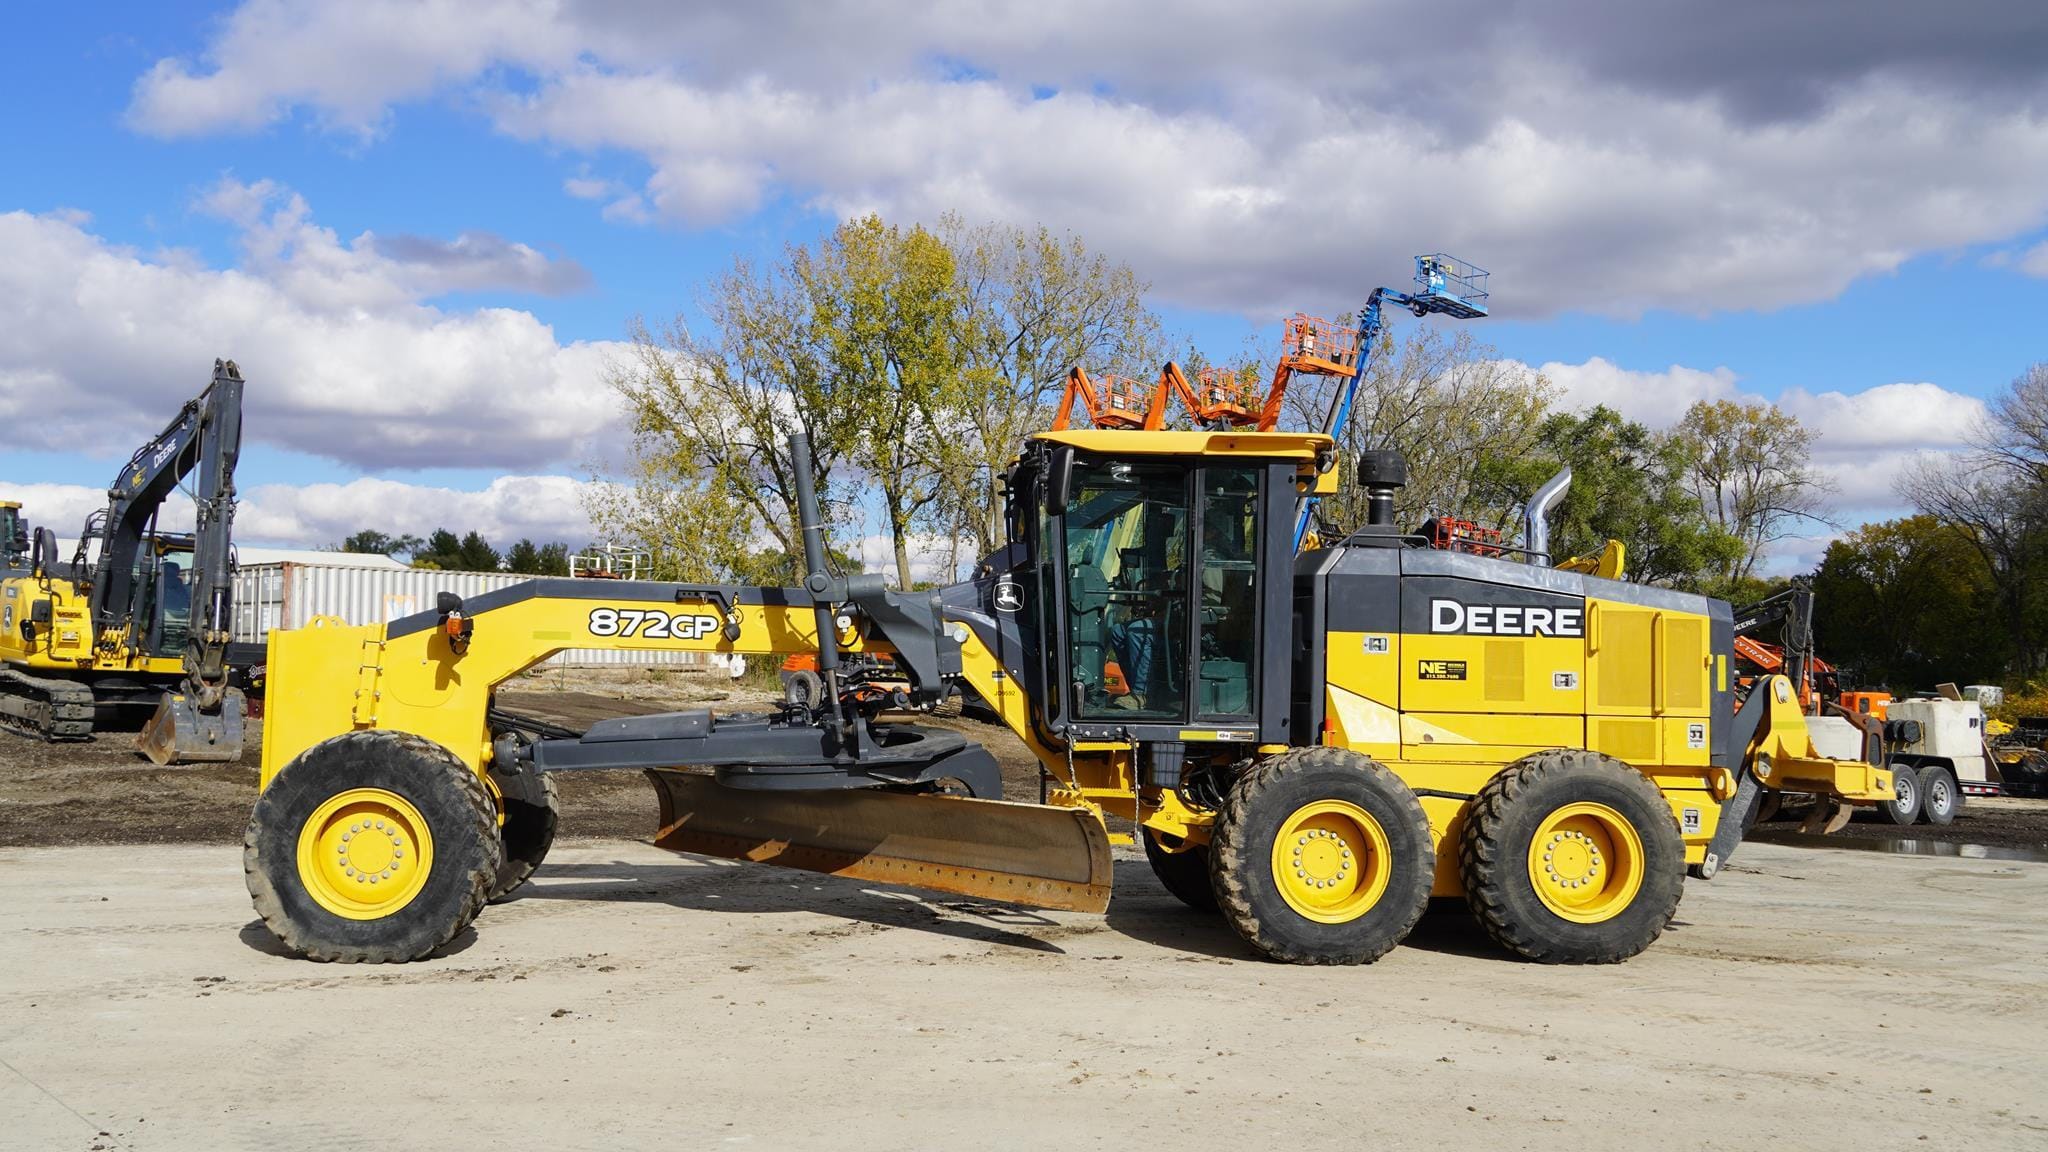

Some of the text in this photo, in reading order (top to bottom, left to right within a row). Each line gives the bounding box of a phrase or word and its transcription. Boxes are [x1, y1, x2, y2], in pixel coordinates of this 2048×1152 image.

[154, 438, 176, 469] DEERE
[588, 608, 719, 640] 872GP
[1432, 600, 1581, 635] DEERE
[1420, 662, 1447, 674] NE
